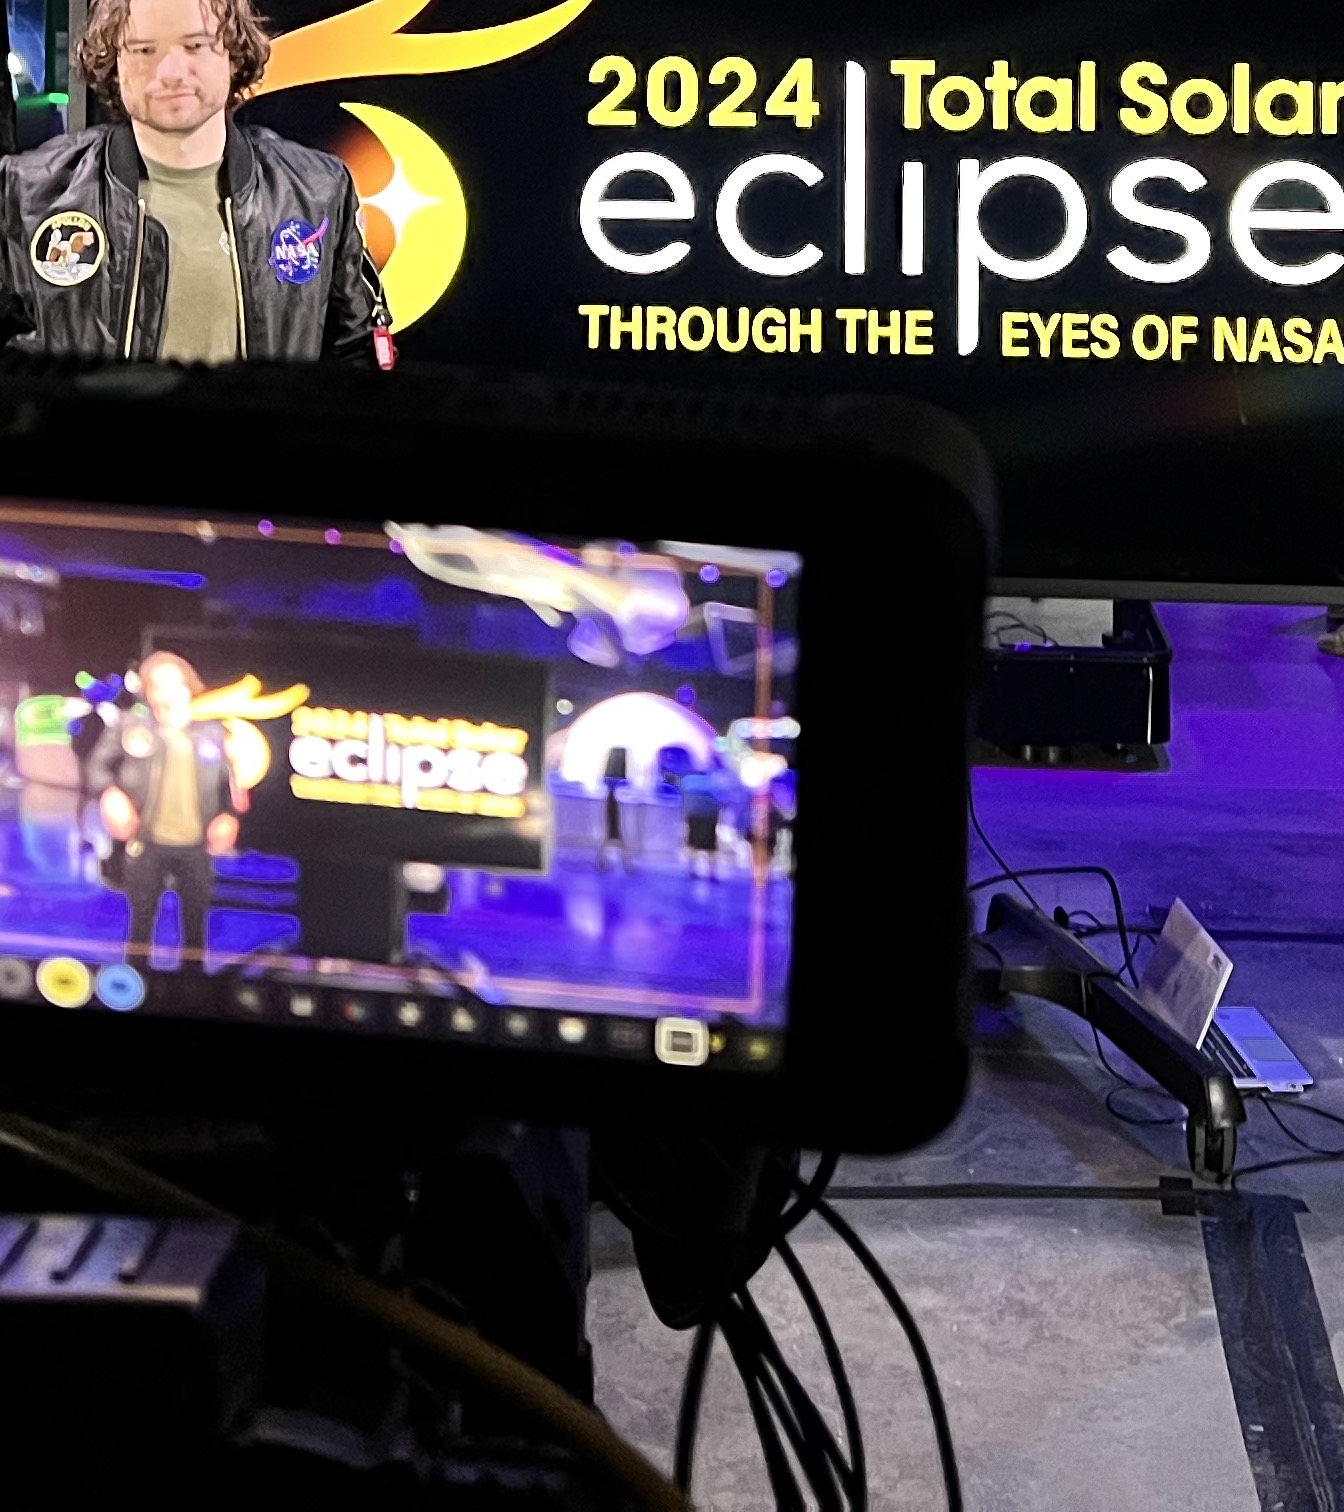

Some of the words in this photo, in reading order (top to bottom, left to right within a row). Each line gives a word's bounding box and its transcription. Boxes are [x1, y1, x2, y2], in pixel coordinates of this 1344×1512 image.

[587, 55, 819, 128] 2024
[890, 59, 1095, 133] Total
[578, 305, 822, 354] THROUGH
[836, 308, 933, 355] THE
[1001, 312, 1121, 357] EYES
[1132, 314, 1197, 361] OF
[289, 713, 528, 809] eclipse
